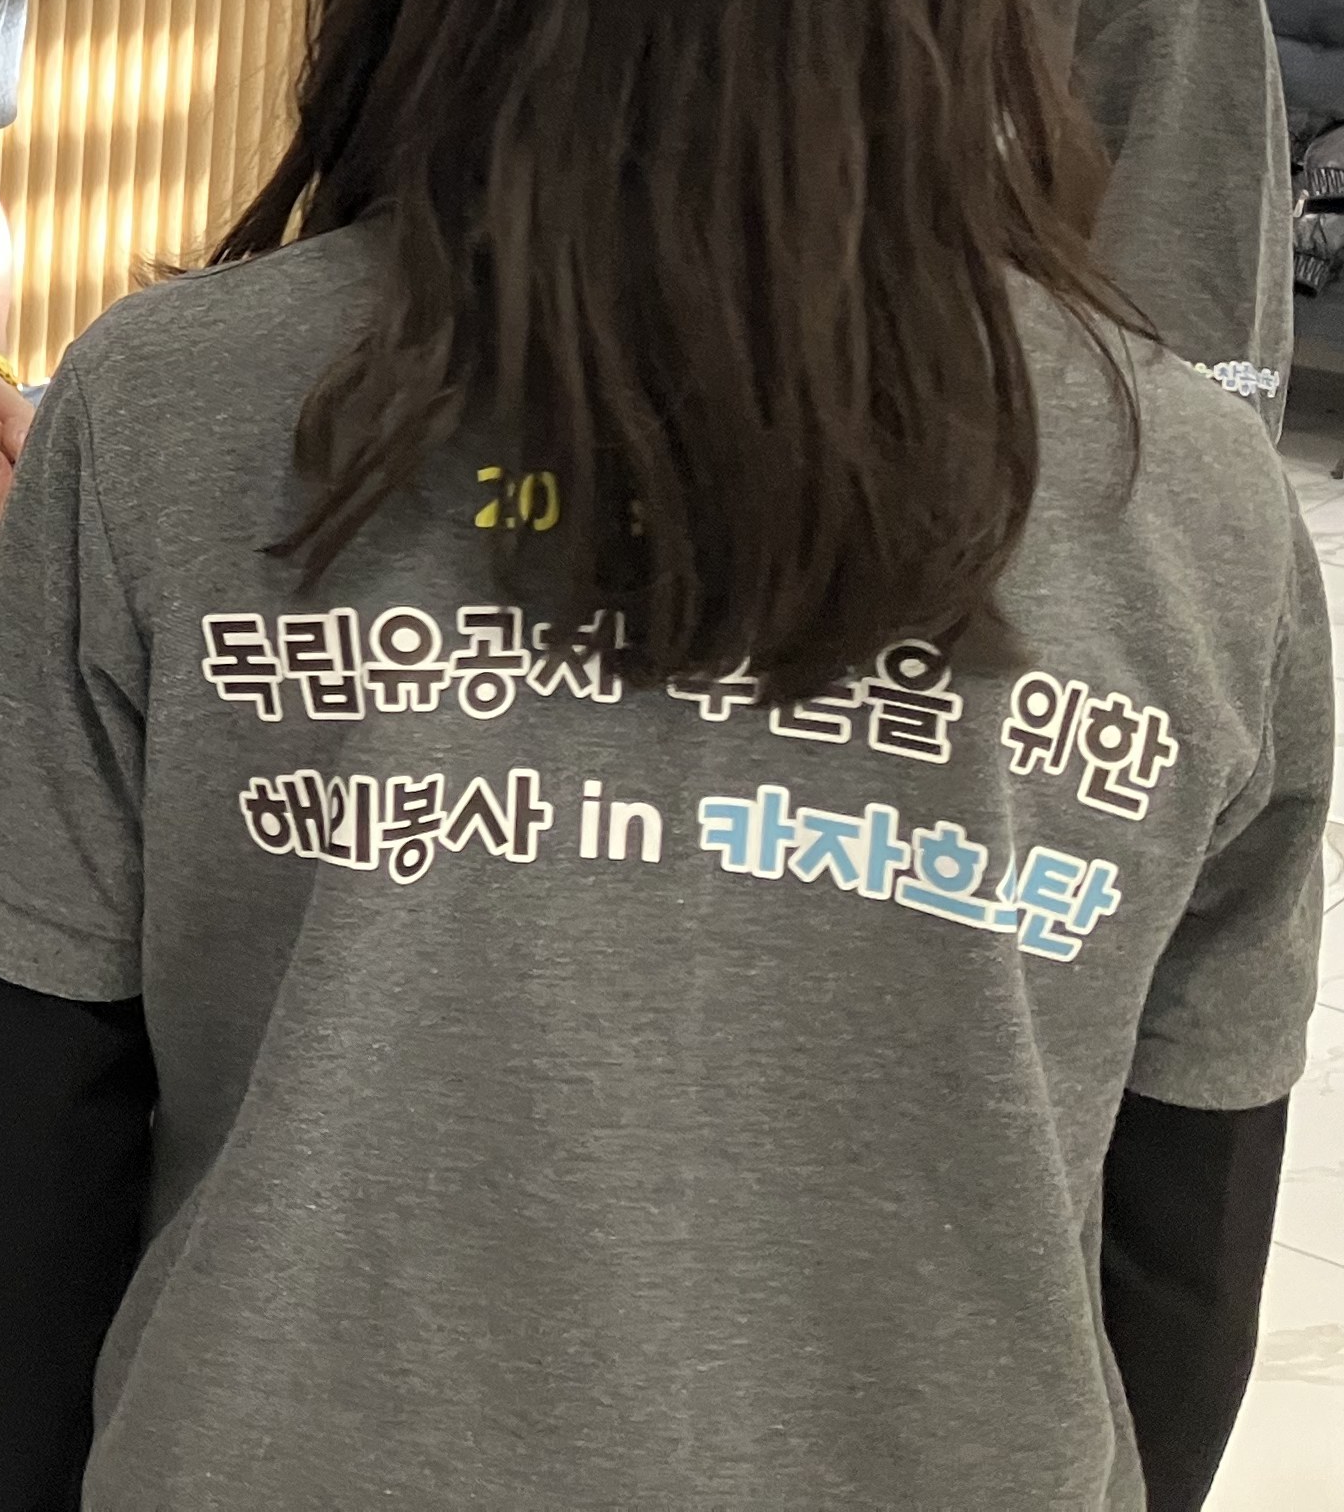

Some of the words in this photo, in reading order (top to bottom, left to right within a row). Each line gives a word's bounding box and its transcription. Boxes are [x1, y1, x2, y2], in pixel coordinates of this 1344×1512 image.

[202, 606, 627, 722] 독립유공자
[1001, 671, 1179, 821] 위한
[239, 768, 554, 885] 해외봉사
[579, 779, 663, 863] in
